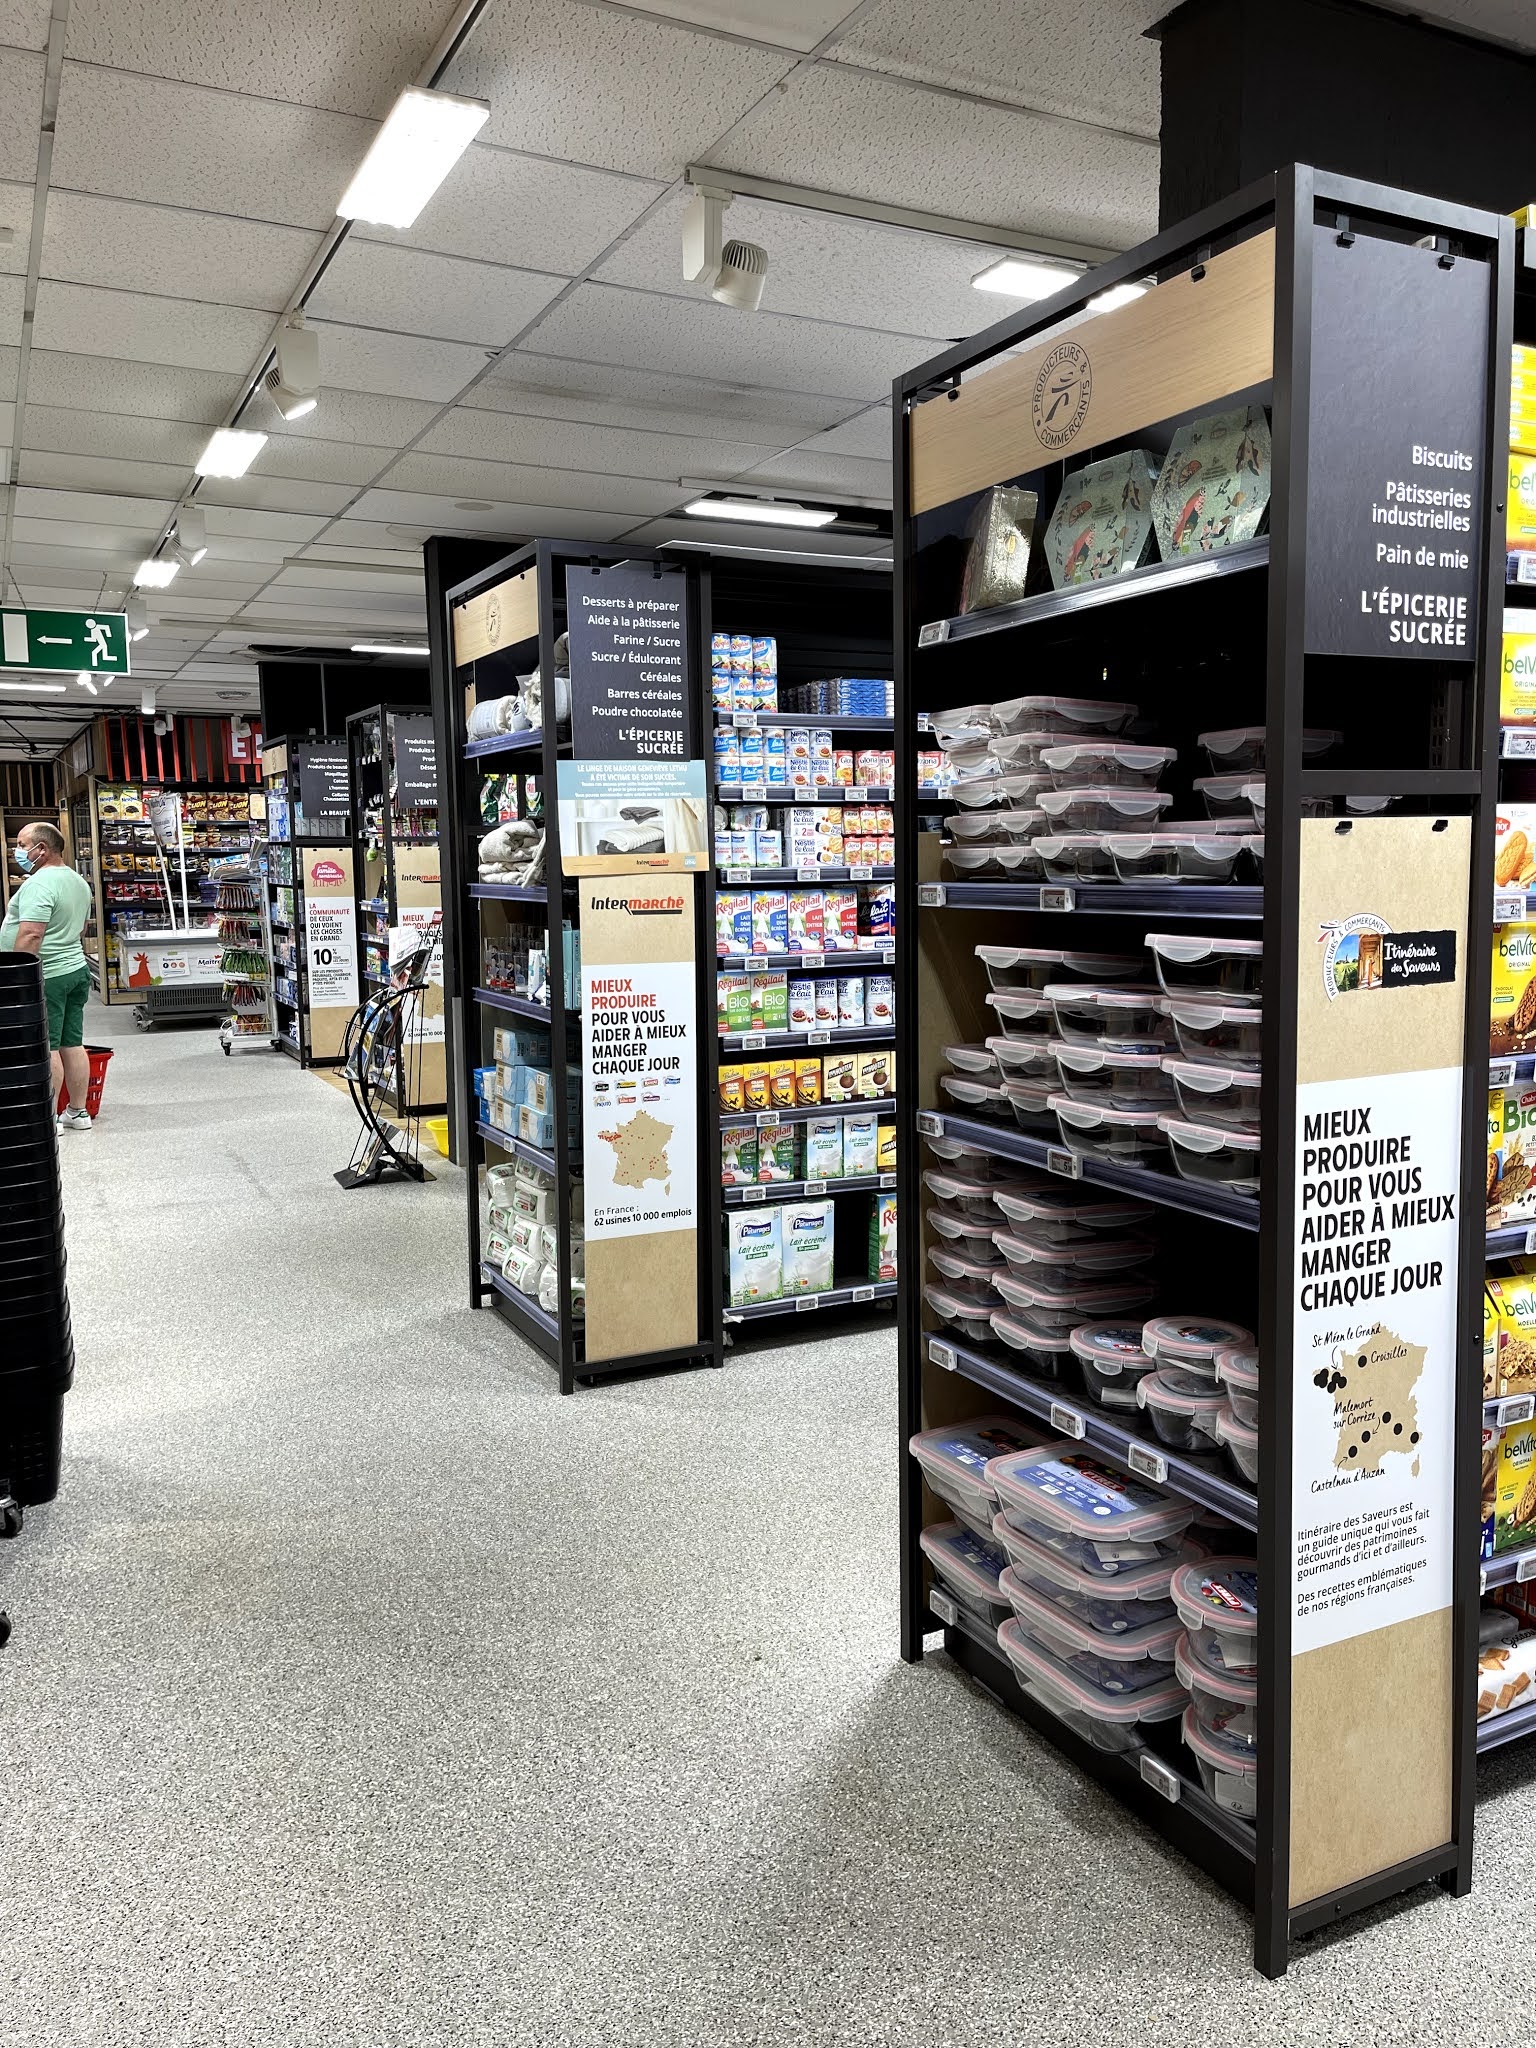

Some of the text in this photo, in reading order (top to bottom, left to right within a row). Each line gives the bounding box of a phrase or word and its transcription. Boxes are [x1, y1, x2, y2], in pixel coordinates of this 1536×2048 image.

[1034, 346, 1087, 413] PRODUCTEURS &
[1412, 446, 1472, 471] Biscuits
[1387, 482, 1471, 509] Pâtisseries
[1372, 504, 1470, 531] industrielles
[1377, 543, 1468, 569] Pain de mie
[583, 596, 679, 611] Desserts à préparer
[1361, 586, 1467, 618] L'ÉPICERIE
[588, 615, 680, 629] Aide à la pâtisserie
[614, 635, 680, 647] Farine / Sucre
[1390, 619, 1466, 645] SUCRÉE
[592, 651, 681, 665] Sucre / Édulcorant
[640, 672, 681, 683] Céréales
[608, 689, 682, 700] Barres céréales
[592, 706, 682, 718] Poudre chocolatée
[619, 727, 683, 741] L'ÉPICERIE
[637, 741, 683, 754] SUCRÉE
[591, 896, 684, 912] Intermarché
[314, 949, 332, 965] 10
[1325, 939, 1339, 997] PRODUCTEURS
[1345, 917, 1385, 933] COMMERÇANTS
[1384, 942, 1437, 960] Itinéraire
[1391, 959, 1441, 978] des Saveurs
[592, 979, 632, 993] MIEUX
[592, 994, 656, 1009] PRODUIRE
[592, 1010, 665, 1026] POUR VOUS
[592, 1024, 686, 1043] AIDER À MIEUX
[592, 1043, 647, 1059] MANGER
[593, 1057, 680, 1076] CHAQUE JOUR
[1304, 1107, 1372, 1142] MIEUX
[724, 1127, 755, 1146] Régilait
[760, 1125, 791, 1144] Régilait
[1304, 1135, 1411, 1176] PRODUIRE
[1303, 1167, 1422, 1210] POUR VOUS
[594, 1208, 692, 1226] 62 usines 10 000 emplois
[607, 1205, 634, 1214] France
[795, 1219, 824, 1230] Pâturages
[1301, 1194, 1455, 1245] AIDER À MIEUX
[743, 1226, 771, 1237] Pâturages
[790, 1236, 827, 1246] Lait écrémé
[738, 1243, 775, 1254] Lait écrémé
[1302, 1238, 1391, 1278] MANGER
[1301, 1261, 1442, 1312] CHAQUE JOUR
[1312, 1323, 1381, 1348] St Méen le Grand
[1371, 1345, 1407, 1363] Croisilles
[1334, 1397, 1373, 1416] Malemort
[1333, 1411, 1376, 1429] sur Corrèze
[1311, 1467, 1385, 1494] Castelnau d'Auzan
[1298, 1501, 1413, 1541] Itinéraire des Saveurs est
[1298, 1509, 1429, 1553] un guide unique qui vous fait
[1298, 1525, 1417, 1566] découvrir des patrimoines
[1298, 1535, 1427, 1581] gourmands d'ici et d'ailleurs.
[1298, 1558, 1427, 1604] Des recettes emblématiques
[1298, 1575, 1415, 1616] de nos régions françaises.
